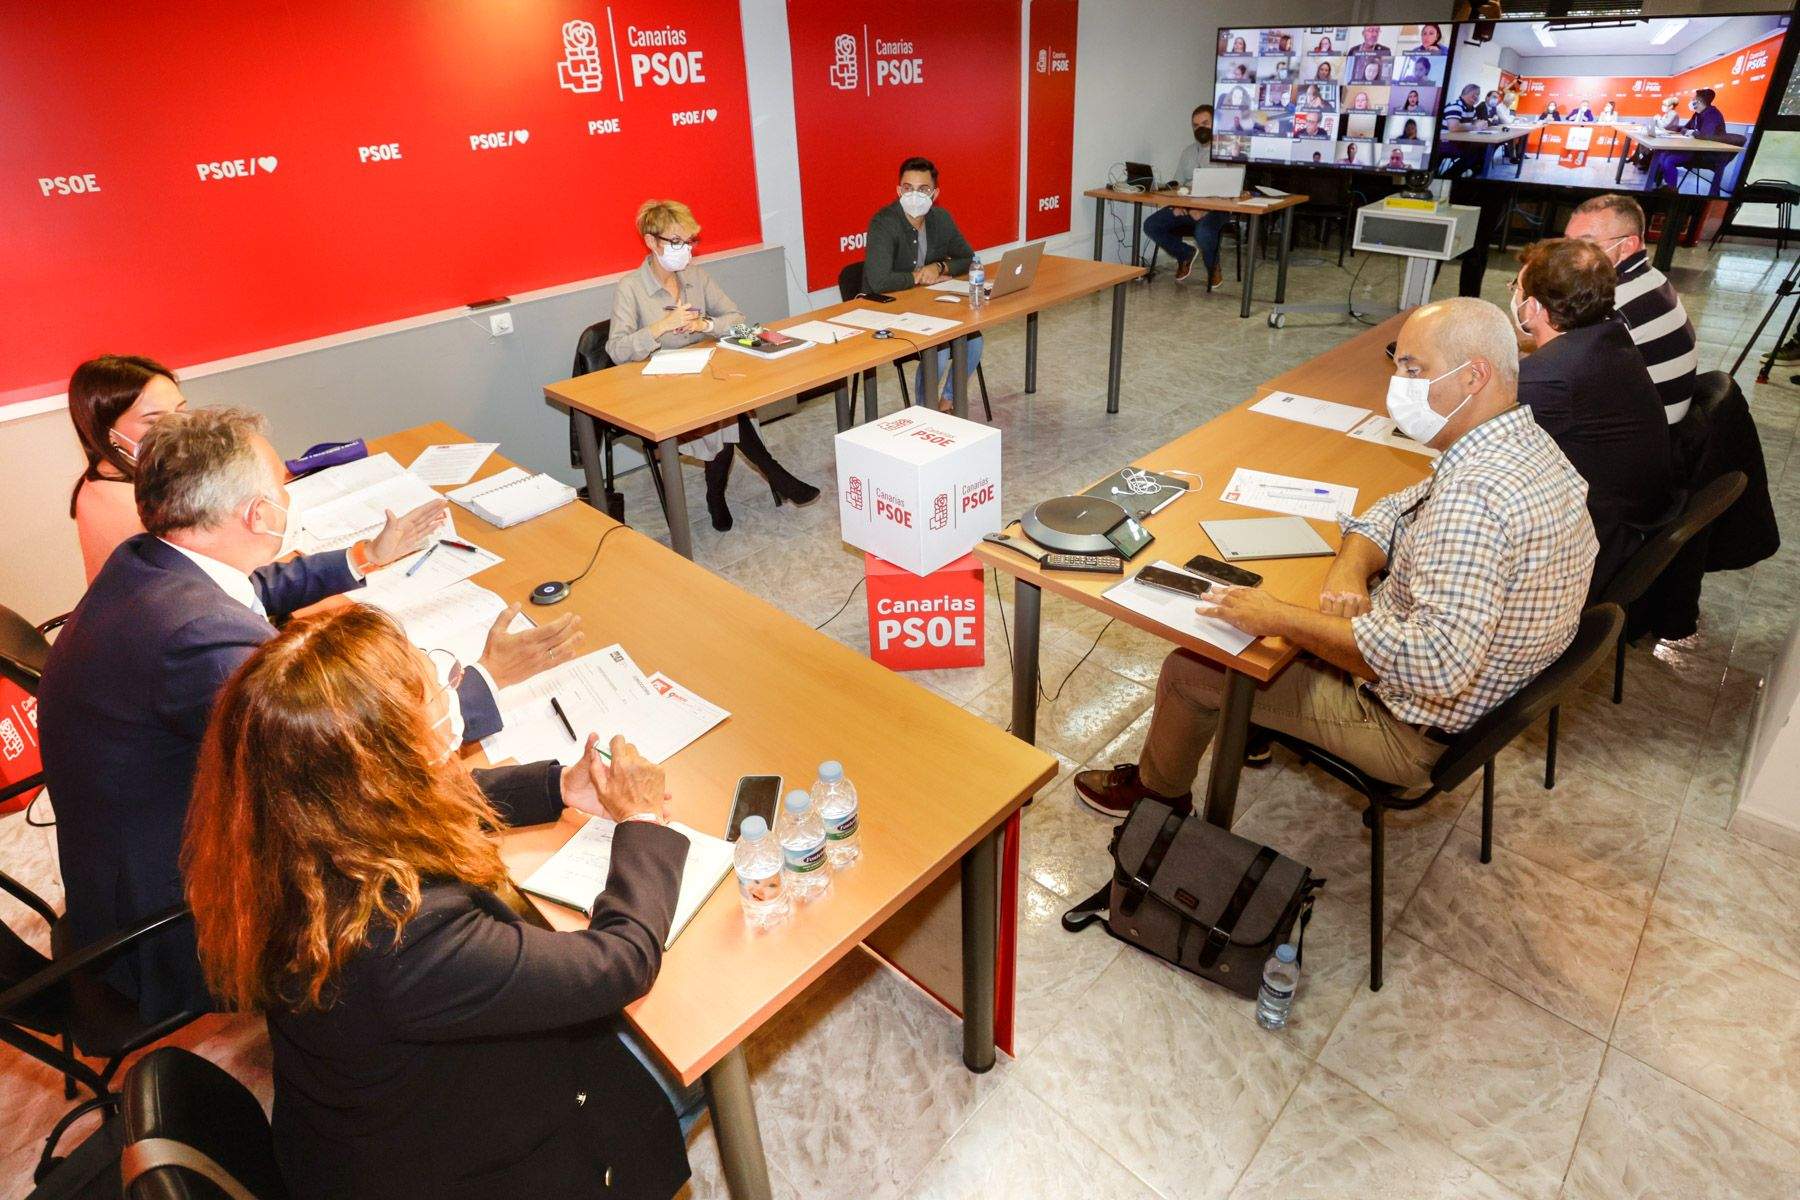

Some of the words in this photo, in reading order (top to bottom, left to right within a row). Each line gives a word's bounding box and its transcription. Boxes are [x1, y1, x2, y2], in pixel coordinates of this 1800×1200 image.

[627, 25, 688, 48] Canarias
[875, 38, 915, 56] Canarias
[630, 51, 706, 88] PSOE
[876, 58, 924, 86] PSOE
[1051, 59, 1070, 72] PSOE
[587, 118, 621, 136] PSOE
[358, 142, 403, 163] PSOE
[38, 173, 101, 197] PSOE
[1038, 195, 1060, 212] PSOE
[910, 430, 956, 447] PSOE
[962, 477, 990, 495] Canarias
[876, 487, 905, 508] Canarias
[962, 484, 995, 513] PSOE
[876, 499, 913, 529] PSOE
[877, 594, 976, 615] Canarias
[878, 616, 977, 651] PSOE
